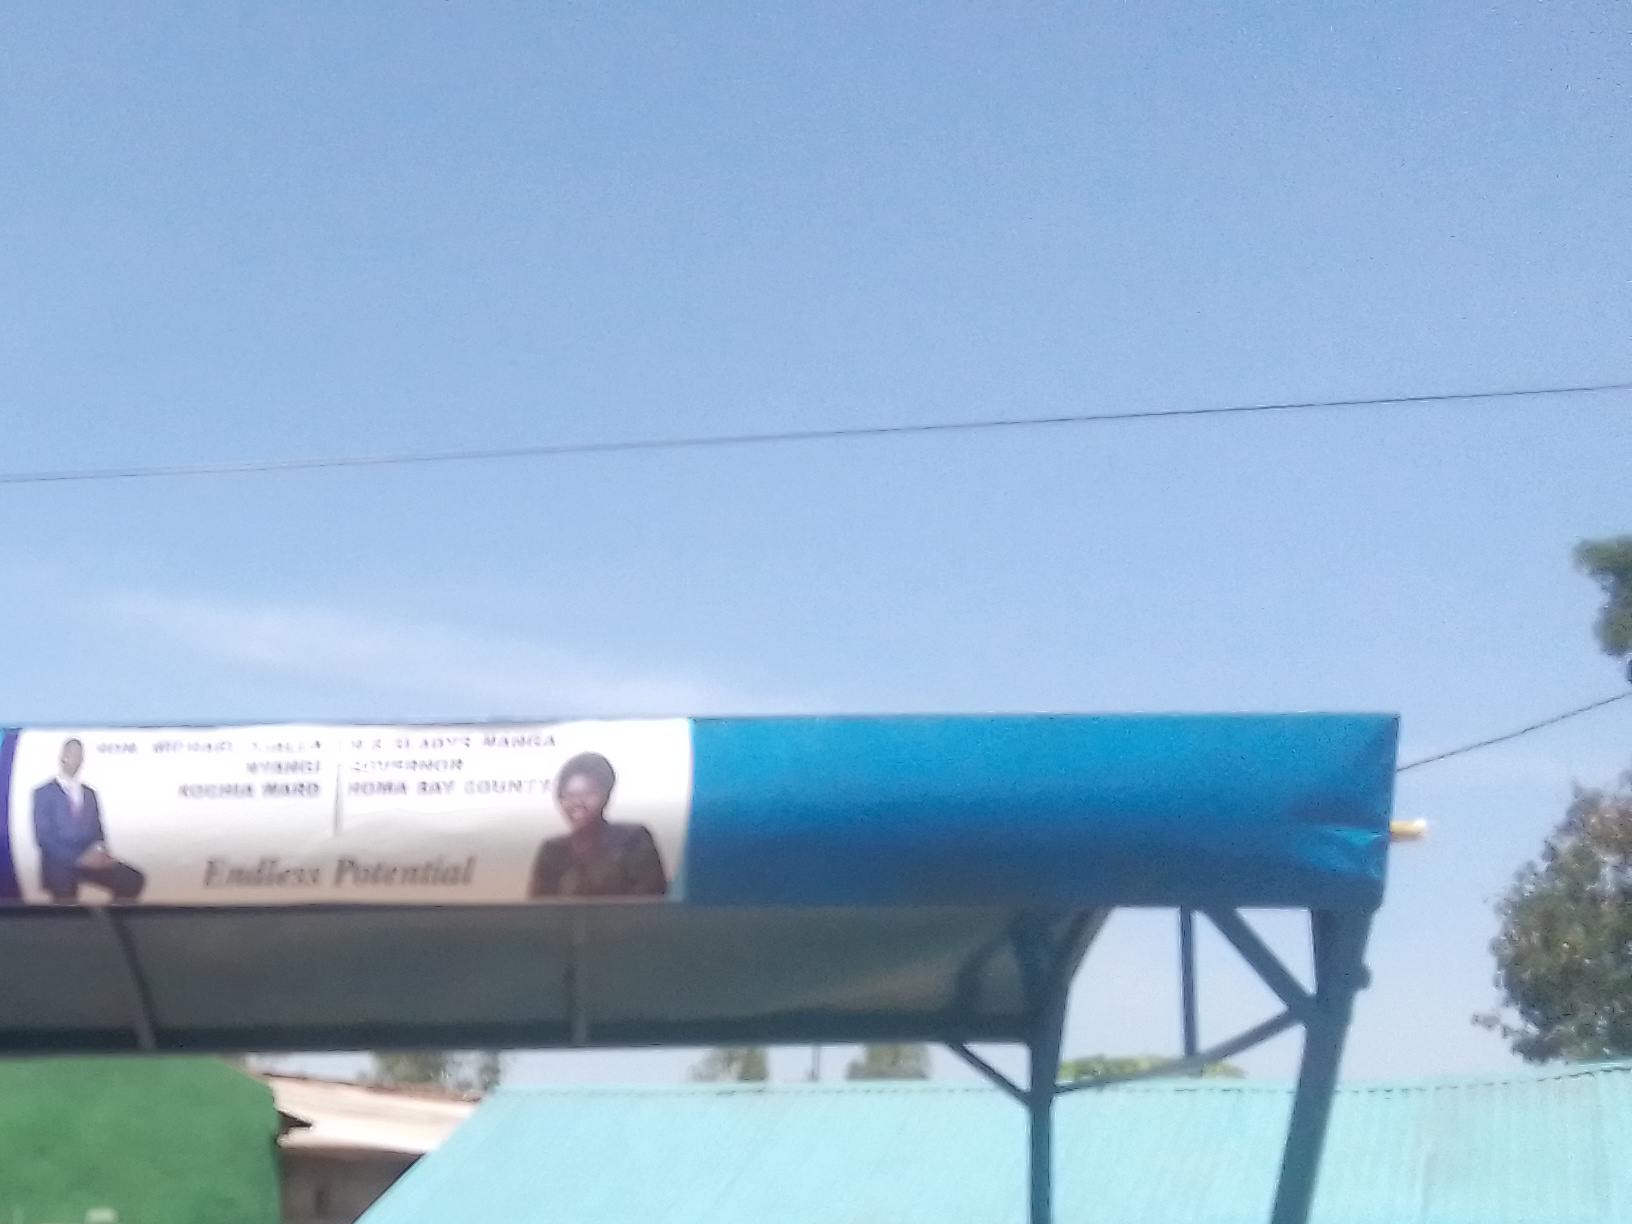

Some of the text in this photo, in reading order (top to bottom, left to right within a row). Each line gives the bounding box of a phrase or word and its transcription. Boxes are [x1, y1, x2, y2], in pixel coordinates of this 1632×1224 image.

[351, 759, 464, 772] GOVERNOR
[262, 782, 322, 798] WARD
[348, 779, 554, 797] HOMA BAY COUNTY
[204, 855, 477, 887] Endless Potential
